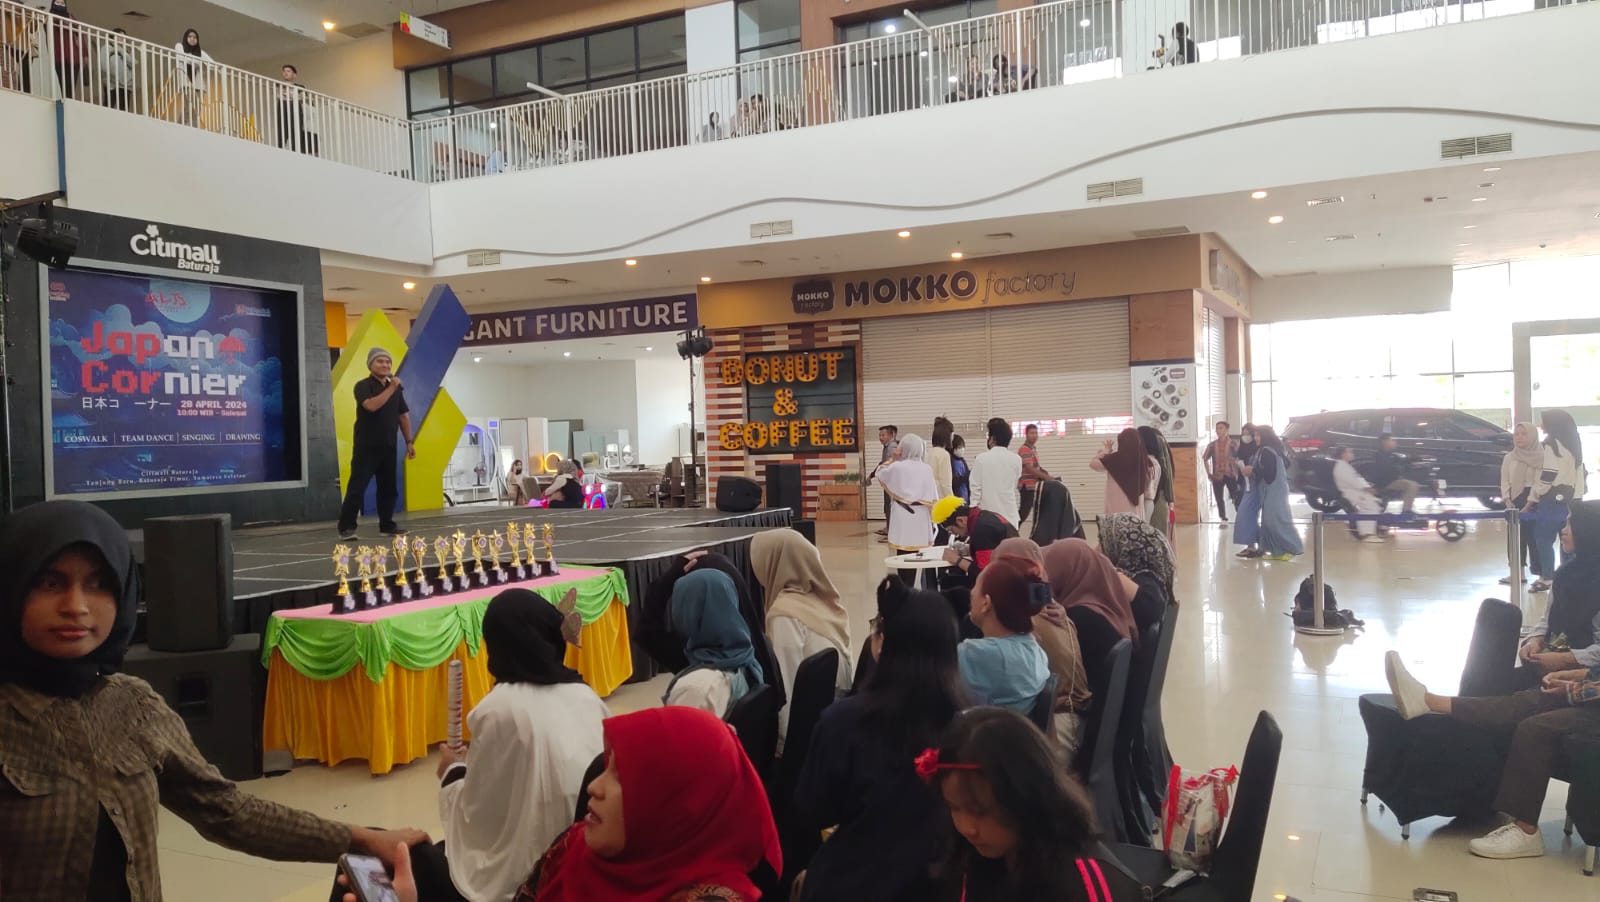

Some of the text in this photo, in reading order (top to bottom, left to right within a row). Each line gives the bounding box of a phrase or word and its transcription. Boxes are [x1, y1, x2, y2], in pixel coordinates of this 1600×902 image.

[130, 233, 220, 264] Citimall
[177, 258, 219, 274] Baturaja
[797, 291, 829, 302] MOKKO
[844, 269, 1077, 308] MOKKO factory
[536, 301, 688, 336] FURNITURE
[81, 360, 247, 396] Cornier
[721, 352, 843, 385] DONUT
[180, 400, 247, 409] 28 APRIL 2024
[773, 388, 798, 416] &
[64, 433, 261, 443] COSWALK TEAM DANCE SINGING DRAWING
[720, 418, 854, 450] COFFEE
